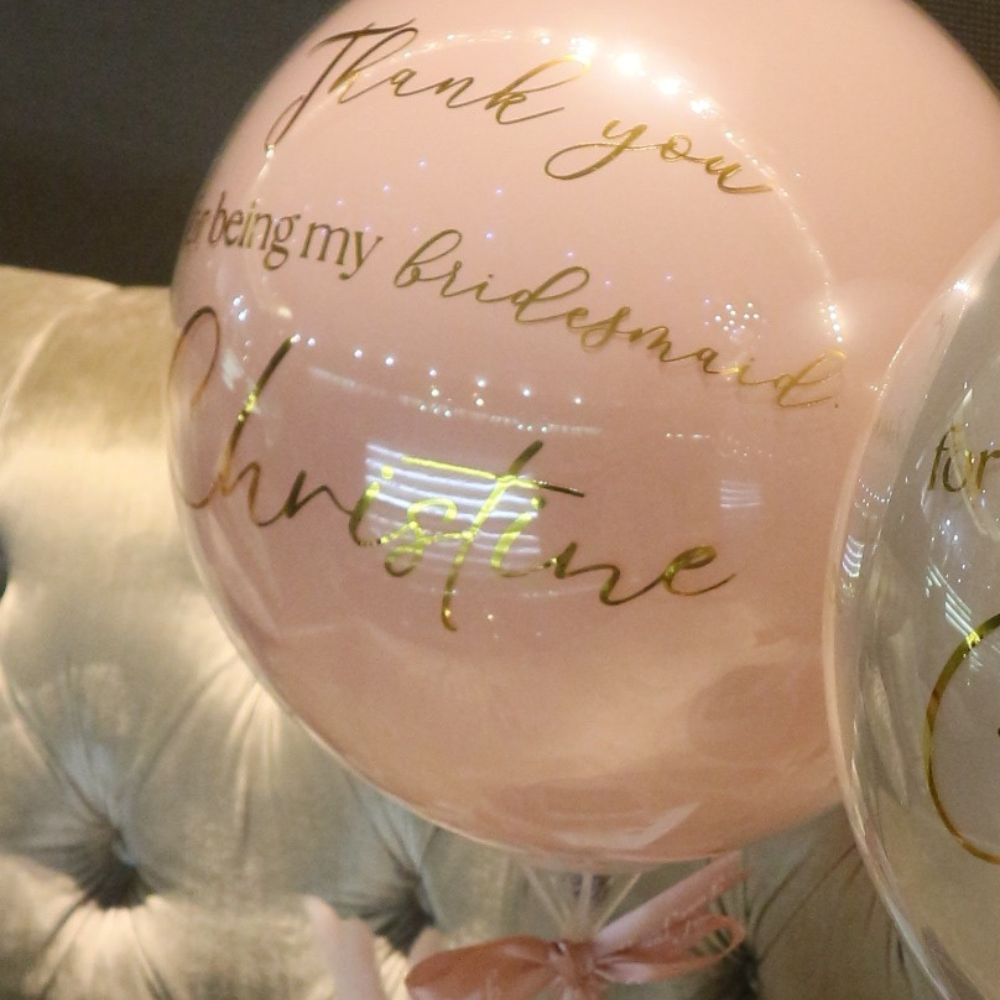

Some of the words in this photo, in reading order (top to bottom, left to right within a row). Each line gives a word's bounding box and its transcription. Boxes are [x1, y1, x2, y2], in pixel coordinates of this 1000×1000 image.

[266, 18, 590, 148] Thank
[545, 118, 771, 195] you
[208, 191, 301, 271] being
[300, 221, 384, 281] my
[166, 305, 736, 632] Christine
